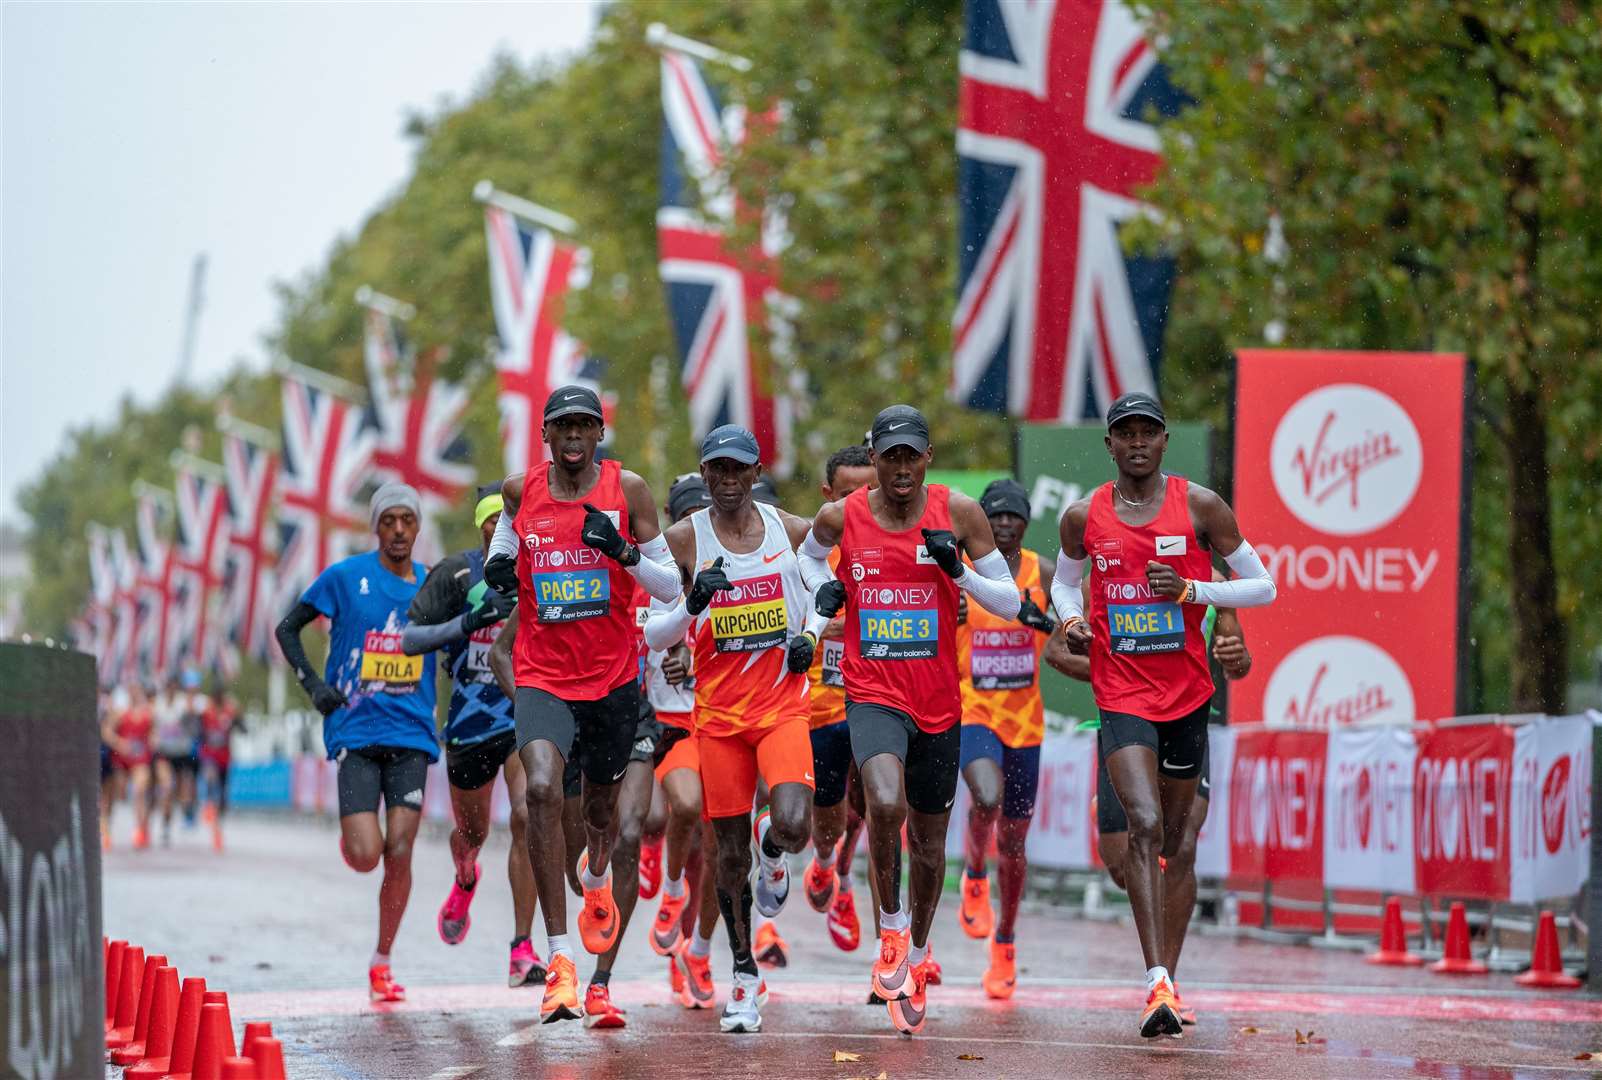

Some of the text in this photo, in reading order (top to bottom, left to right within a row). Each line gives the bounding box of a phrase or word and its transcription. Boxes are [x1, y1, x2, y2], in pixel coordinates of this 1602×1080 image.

[1290, 409, 1403, 511] Virgin
[534, 548, 602, 567] MONEY
[1108, 558, 1120, 566] NN
[1254, 544, 1439, 592] MONEY
[541, 578, 602, 601] PACE 2
[861, 588, 934, 604] MONEY
[562, 612, 576, 620] new
[576, 608, 603, 618] balance
[715, 607, 785, 635] KIPCHOGE
[1114, 610, 1173, 633] PACE 1
[867, 618, 930, 639] PACE 3
[973, 630, 1033, 647] MONEY
[758, 638, 783, 649] balance
[1151, 641, 1180, 650] balance
[375, 661, 413, 677] TOLA
[972, 653, 1034, 675] KIPSEREM
[1418, 757, 1510, 863] MONEY
